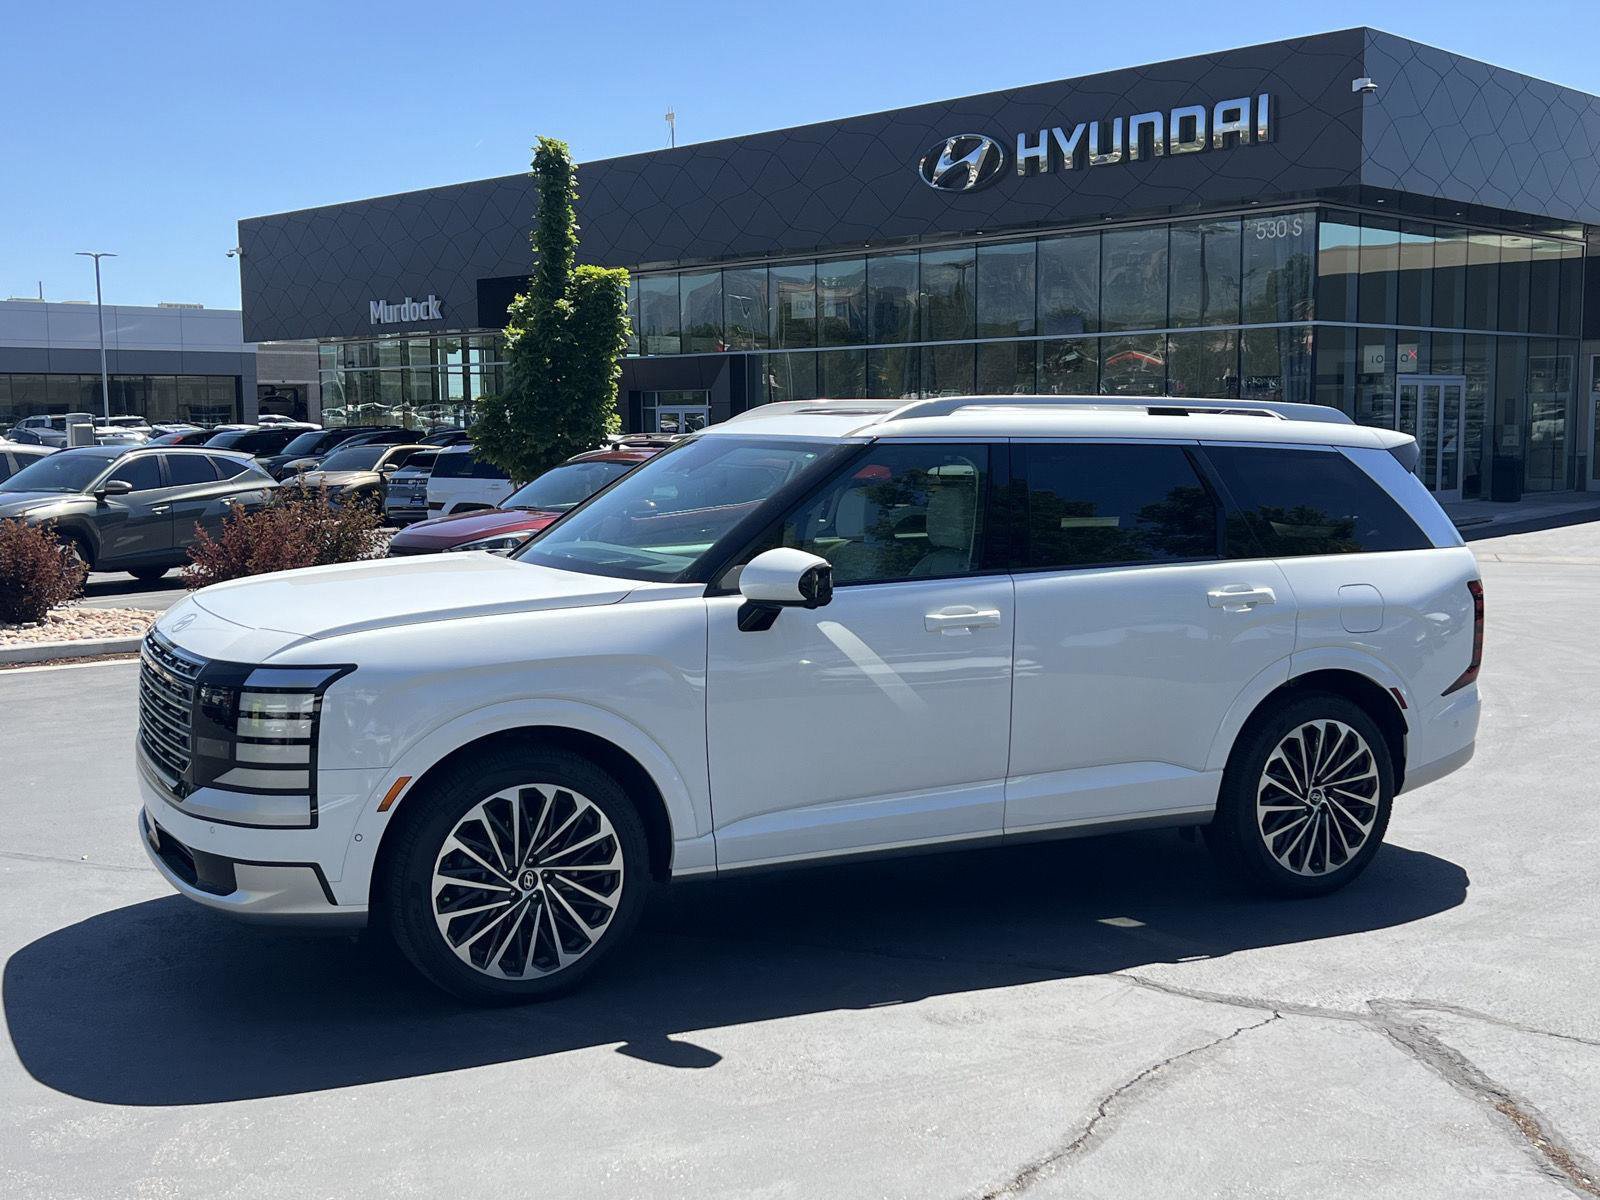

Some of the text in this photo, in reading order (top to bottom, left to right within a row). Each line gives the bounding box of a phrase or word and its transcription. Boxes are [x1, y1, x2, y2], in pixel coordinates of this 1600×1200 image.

[1017, 93, 1270, 177] HYUNDAI
[1256, 218, 1303, 240] 530 S
[369, 294, 443, 325] Murdock
